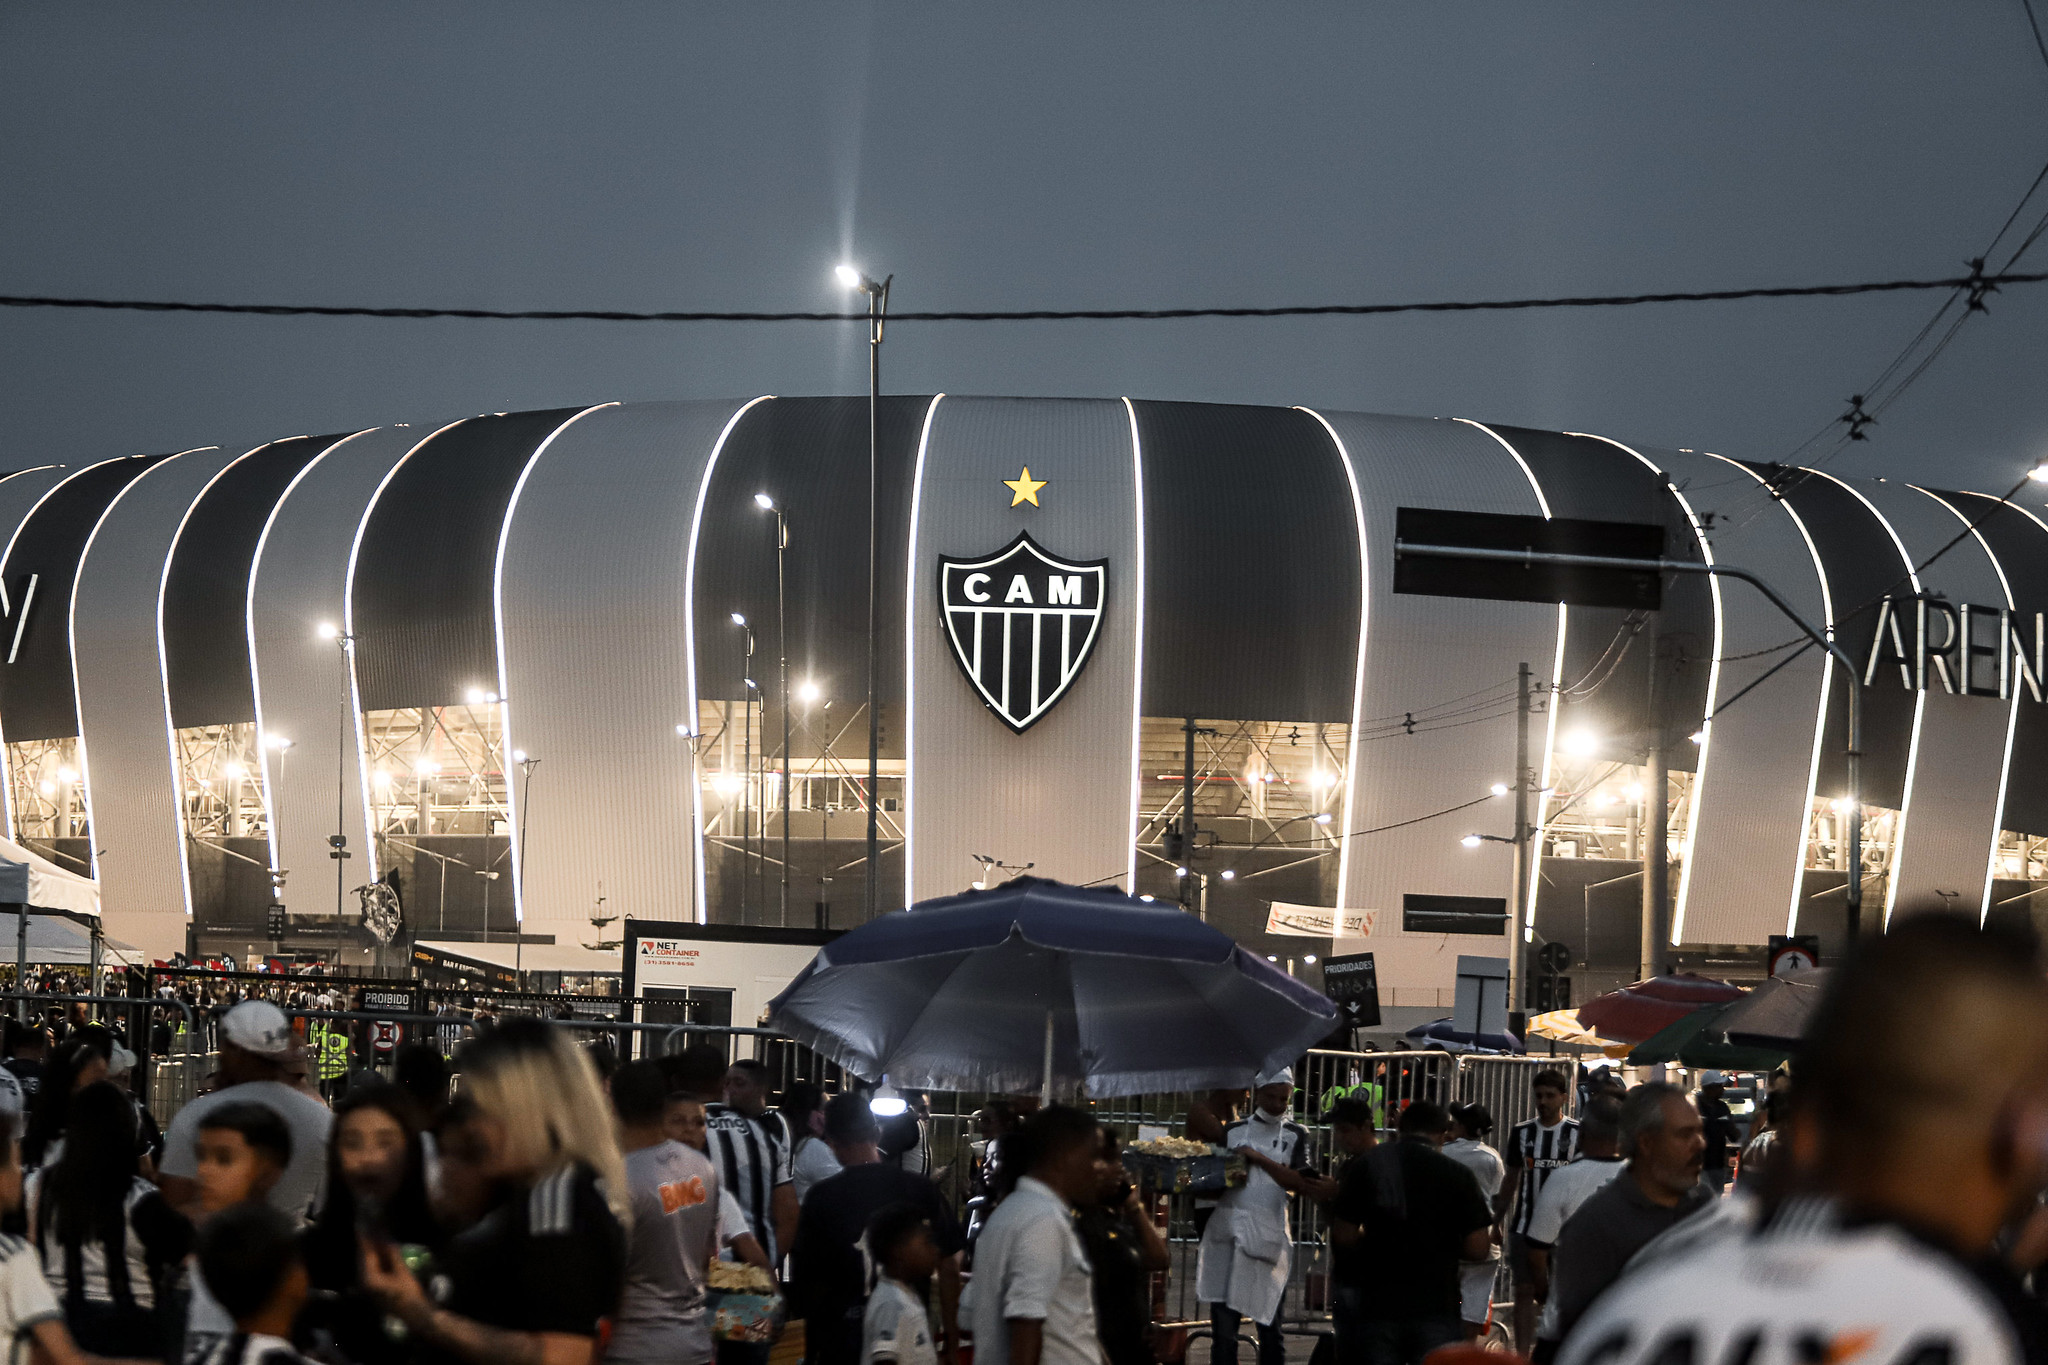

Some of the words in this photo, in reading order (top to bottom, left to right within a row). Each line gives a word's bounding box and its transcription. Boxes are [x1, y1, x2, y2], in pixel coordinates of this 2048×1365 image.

[963, 572, 1082, 605] CAM
[657, 941, 678, 950] NET
[656, 949, 700, 957] CONTAINER
[1324, 960, 1373, 975] PRIORIDADES
[365, 992, 409, 1005] PROIBIDO
[1534, 1159, 1569, 1168] BETANO
